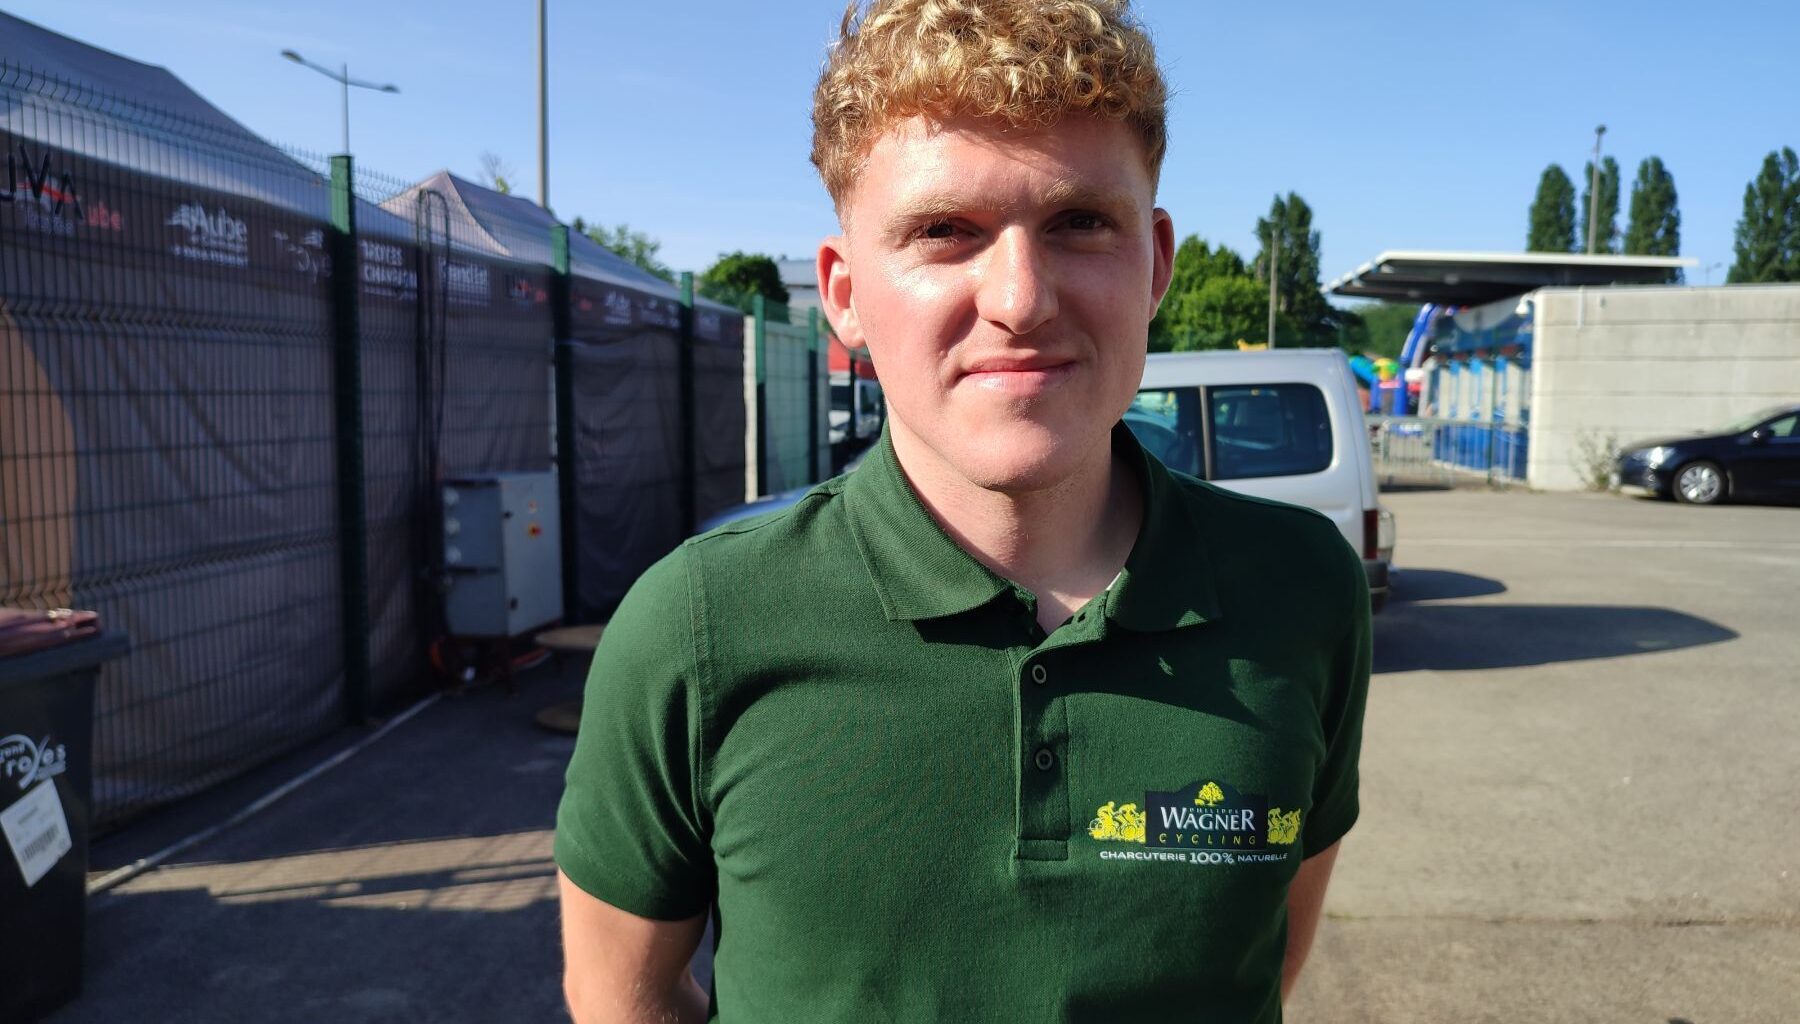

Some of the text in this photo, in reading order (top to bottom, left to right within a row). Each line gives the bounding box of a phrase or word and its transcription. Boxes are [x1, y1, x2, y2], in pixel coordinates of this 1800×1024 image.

[1160, 806, 1256, 831] WAGNER
[1159, 833, 1256, 845] CYCLING
[1100, 850, 1288, 865] CHARCUTERIE 100% NATURELLE
